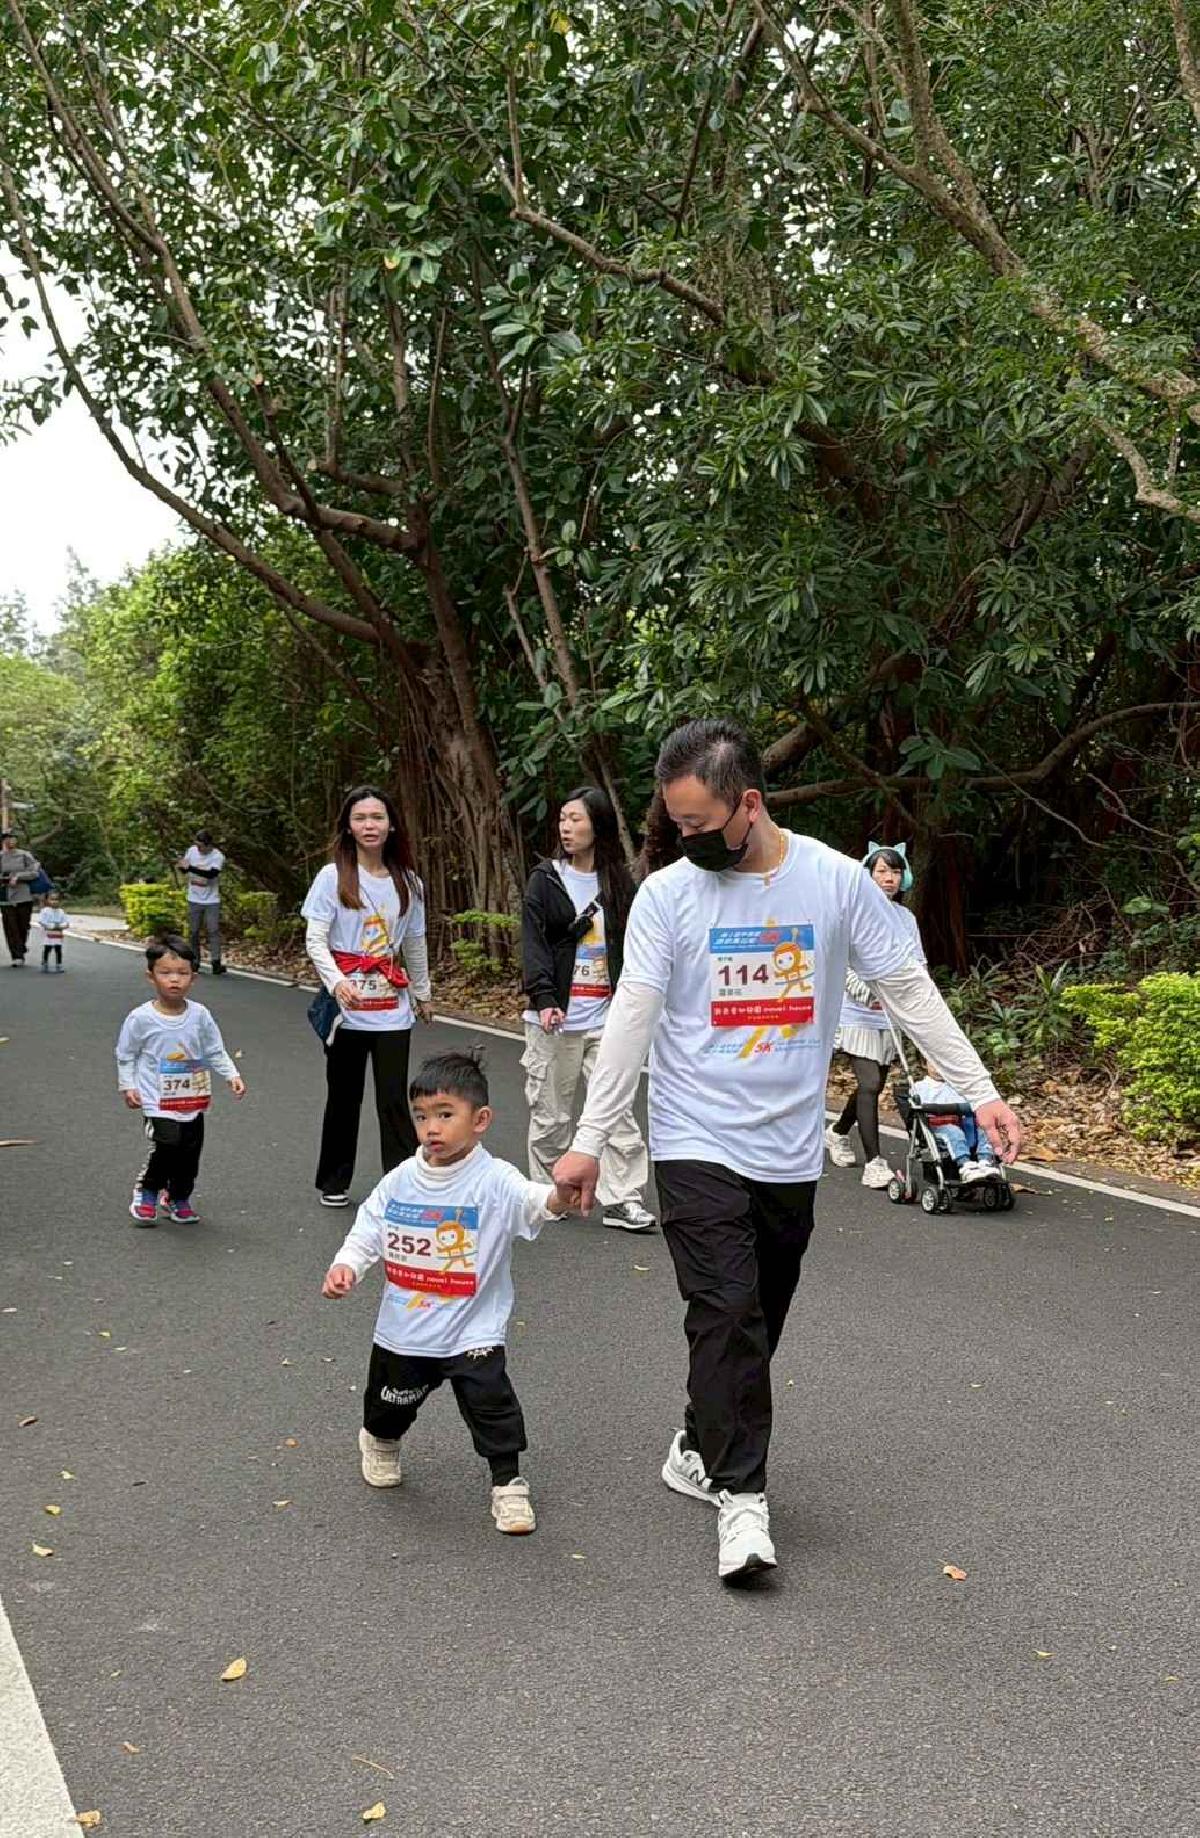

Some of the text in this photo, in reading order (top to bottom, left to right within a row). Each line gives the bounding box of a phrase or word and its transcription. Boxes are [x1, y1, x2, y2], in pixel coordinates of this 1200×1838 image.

[718, 963, 769, 986] 114
[163, 1079, 190, 1090] 374
[387, 1232, 431, 1256] 252
